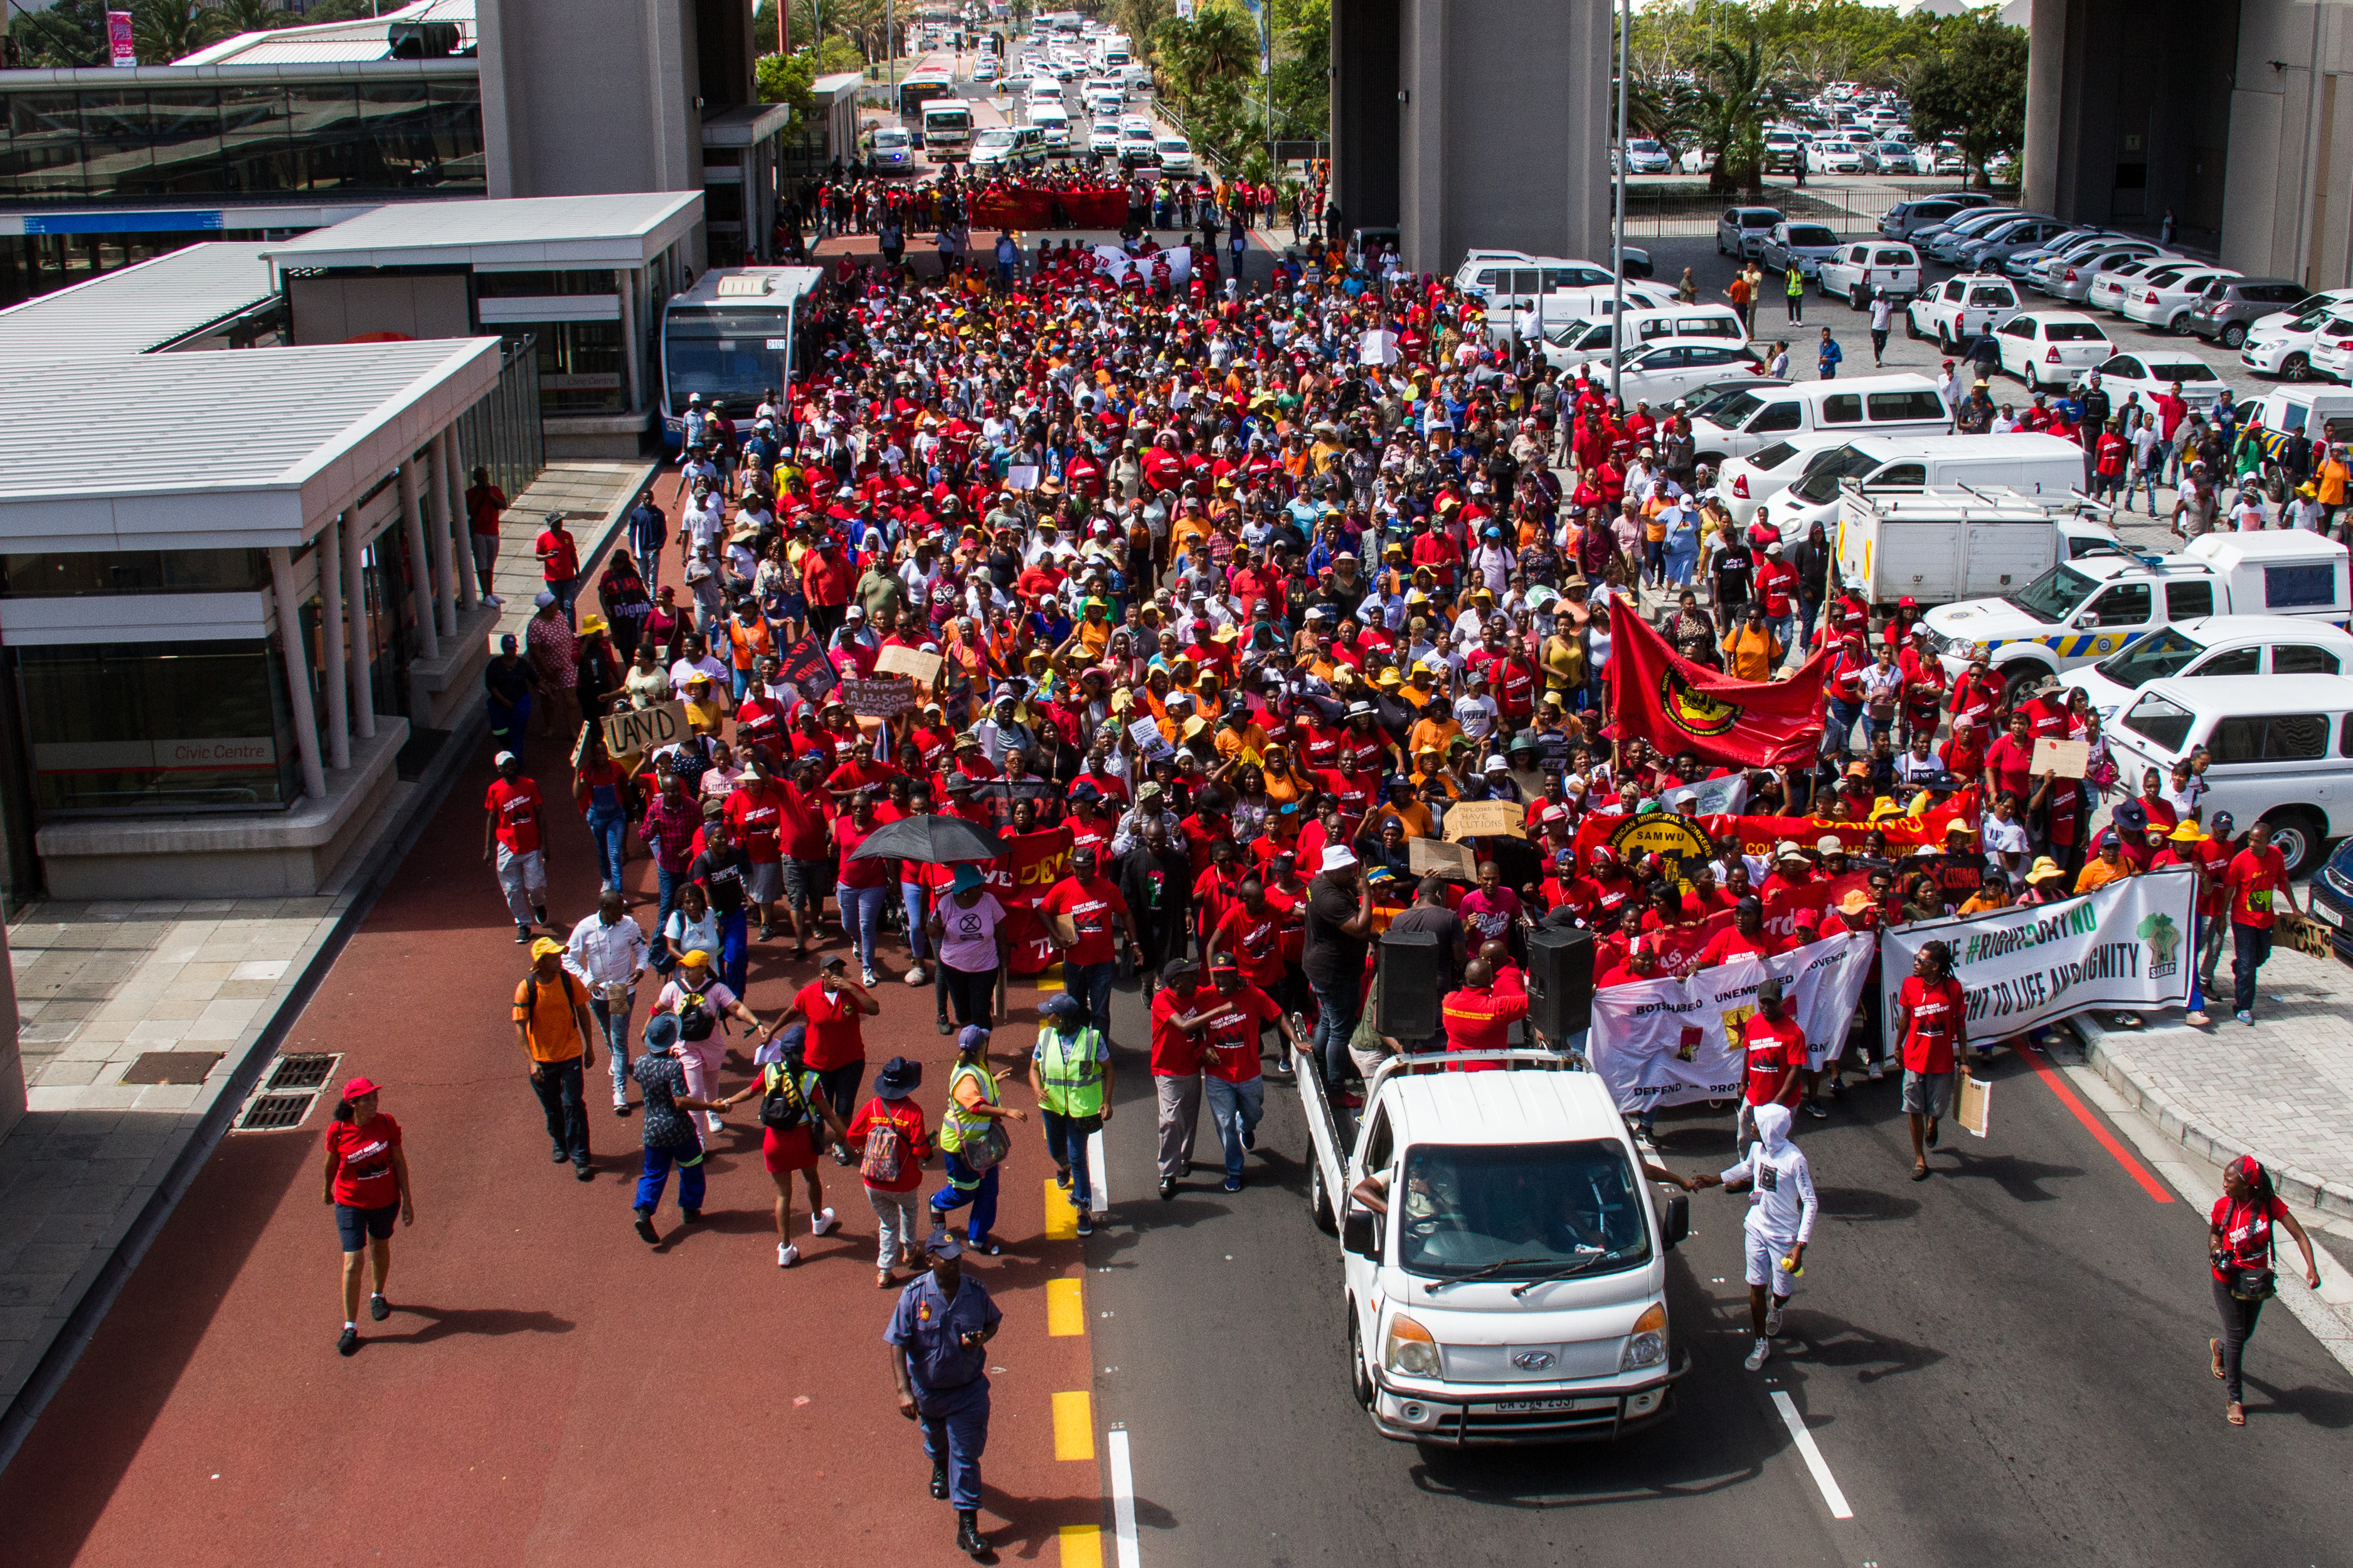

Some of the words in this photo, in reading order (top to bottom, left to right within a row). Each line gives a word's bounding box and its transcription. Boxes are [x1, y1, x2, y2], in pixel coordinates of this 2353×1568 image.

[610, 709, 675, 753] LAND
[176, 746, 211, 760] Civic
[214, 744, 265, 758] Centre
[1636, 832, 1684, 842] SAMWU
[1637, 812, 1681, 824] MUNICIPAL
[1684, 820, 1712, 857] WORKERS
[2295, 939, 2326, 958] LAND
[1992, 982, 2013, 1017] TO
[2012, 972, 2047, 1013] LIFE
[1636, 999, 1702, 1015] BOTSHABELO
[1634, 1083, 1682, 1097] DEFEND
